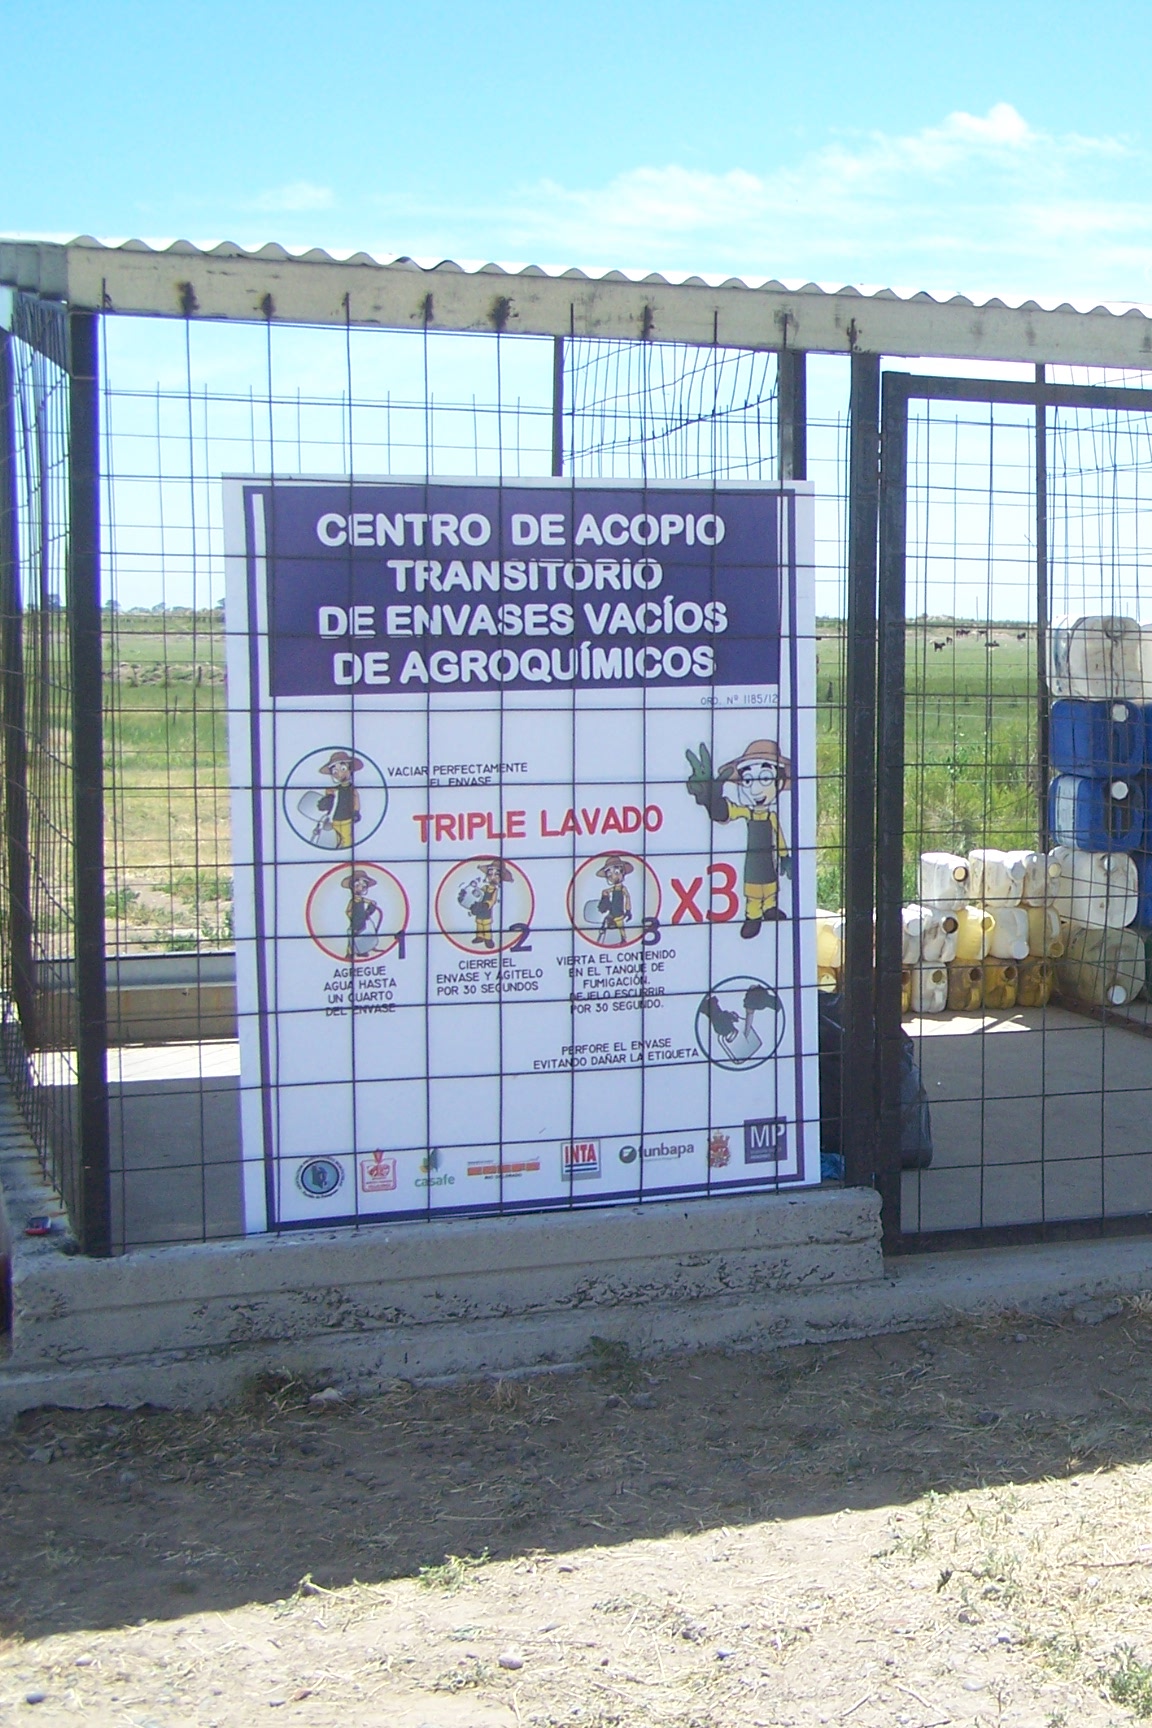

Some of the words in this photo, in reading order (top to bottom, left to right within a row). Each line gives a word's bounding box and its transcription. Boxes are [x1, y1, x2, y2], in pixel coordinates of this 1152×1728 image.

[316, 513, 491, 547] CENTRO
[510, 514, 566, 546] DE
[575, 514, 726, 546] ACOPIO
[387, 559, 663, 592] TRANSITORIO
[318, 605, 376, 639] DE
[386, 603, 574, 638] ENVASES
[583, 596, 728, 635] VACÍOS
[333, 651, 390, 686] DE
[400, 641, 717, 685] AGROQUÍMICOS
[744, 694, 778, 704] 1185/12
[388, 766, 429, 777] VACIAR
[433, 762, 528, 775] PERFECTAMENTE
[430, 778, 441, 787] EL
[448, 777, 492, 786] ENVASE
[413, 811, 526, 843] TRIPLE
[541, 805, 663, 837] LAVADO
[509, 923, 532, 952] 2
[642, 917, 661, 946] 3
[395, 930, 405, 959] 1
[459, 959, 498, 970] CIERRE
[502, 958, 516, 967] EL
[556, 955, 595, 966] VIERTA
[600, 954, 612, 963] EL
[617, 950, 676, 962] CONTENIDO
[333, 966, 386, 978] AGREGUE
[436, 972, 479, 984] ENVASE
[484, 972, 491, 980] Y
[496, 968, 543, 980] AGITELO
[569, 968, 583, 978] EN
[588, 967, 600, 976] EL
[606, 964, 647, 975] TANQUE
[651, 962, 664, 972] DE
[324, 981, 354, 991] AGUA
[359, 978, 397, 989] HASTA
[437, 986, 458, 996] POR
[463, 985, 476, 994] 30
[481, 981, 538, 993] SEGUNDOS
[583, 976, 650, 989] FUMIGACIÓN.
[328, 994, 343, 1004] UN
[348, 990, 393, 1002] CUARTO
[615, 987, 665, 998] ESCURRIR
[326, 1007, 347, 1016] DEL
[354, 1003, 396, 1014] ENVASE
[570, 1004, 591, 1014] POR
[596, 1003, 608, 1012] 30
[613, 999, 664, 1011] SEGUNDO.
[562, 1043, 609, 1055] PERFORE
[614, 1042, 627, 1051] EL
[631, 1038, 671, 1050] ENVASE
[533, 1056, 587, 1070] EVITANDO
[591, 1051, 626, 1066] DAÑAR
[630, 1052, 643, 1062] LA
[648, 1048, 699, 1060] ETIQUETA
[750, 1123, 785, 1148] MP
[564, 1143, 597, 1164] INTA
[638, 1142, 694, 1158] funbapa
[414, 1174, 455, 1188] casafe
